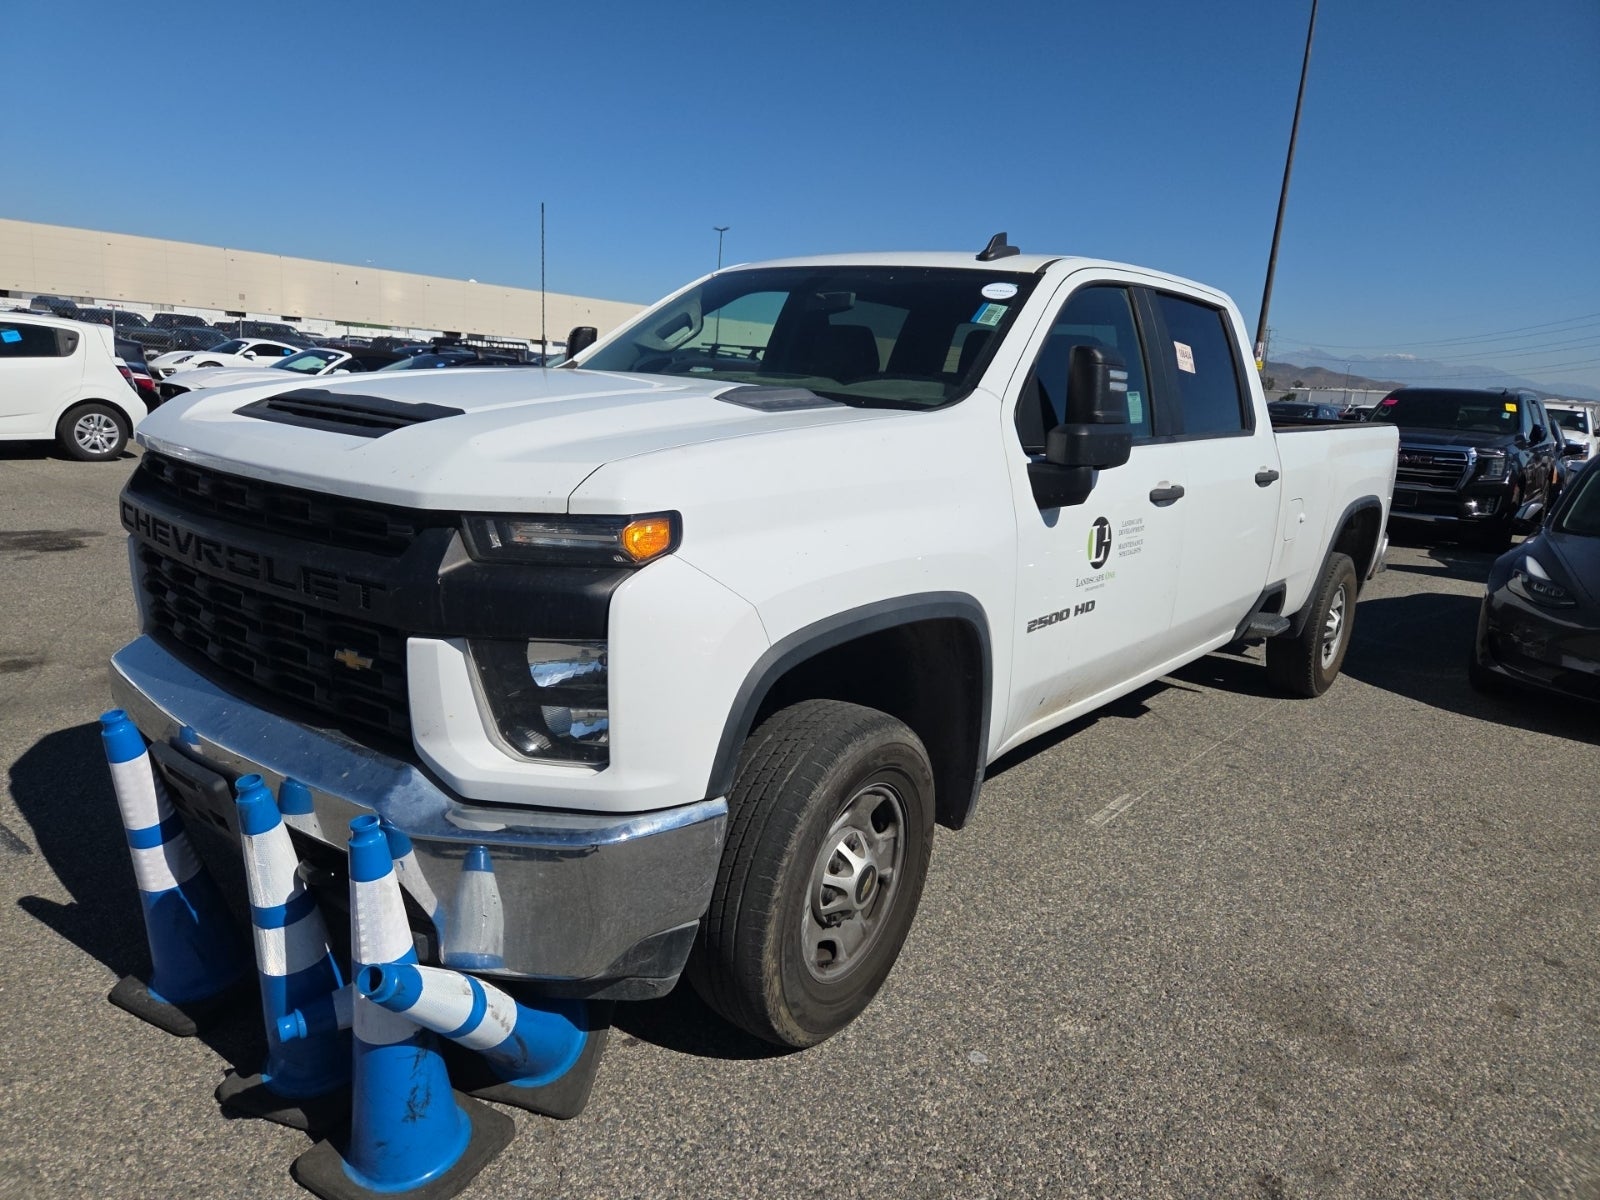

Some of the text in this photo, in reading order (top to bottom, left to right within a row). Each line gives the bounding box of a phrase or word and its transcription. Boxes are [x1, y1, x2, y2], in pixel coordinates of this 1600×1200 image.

[121, 501, 387, 610] CHEVROLET
[1026, 600, 1096, 634] 2500 HD
